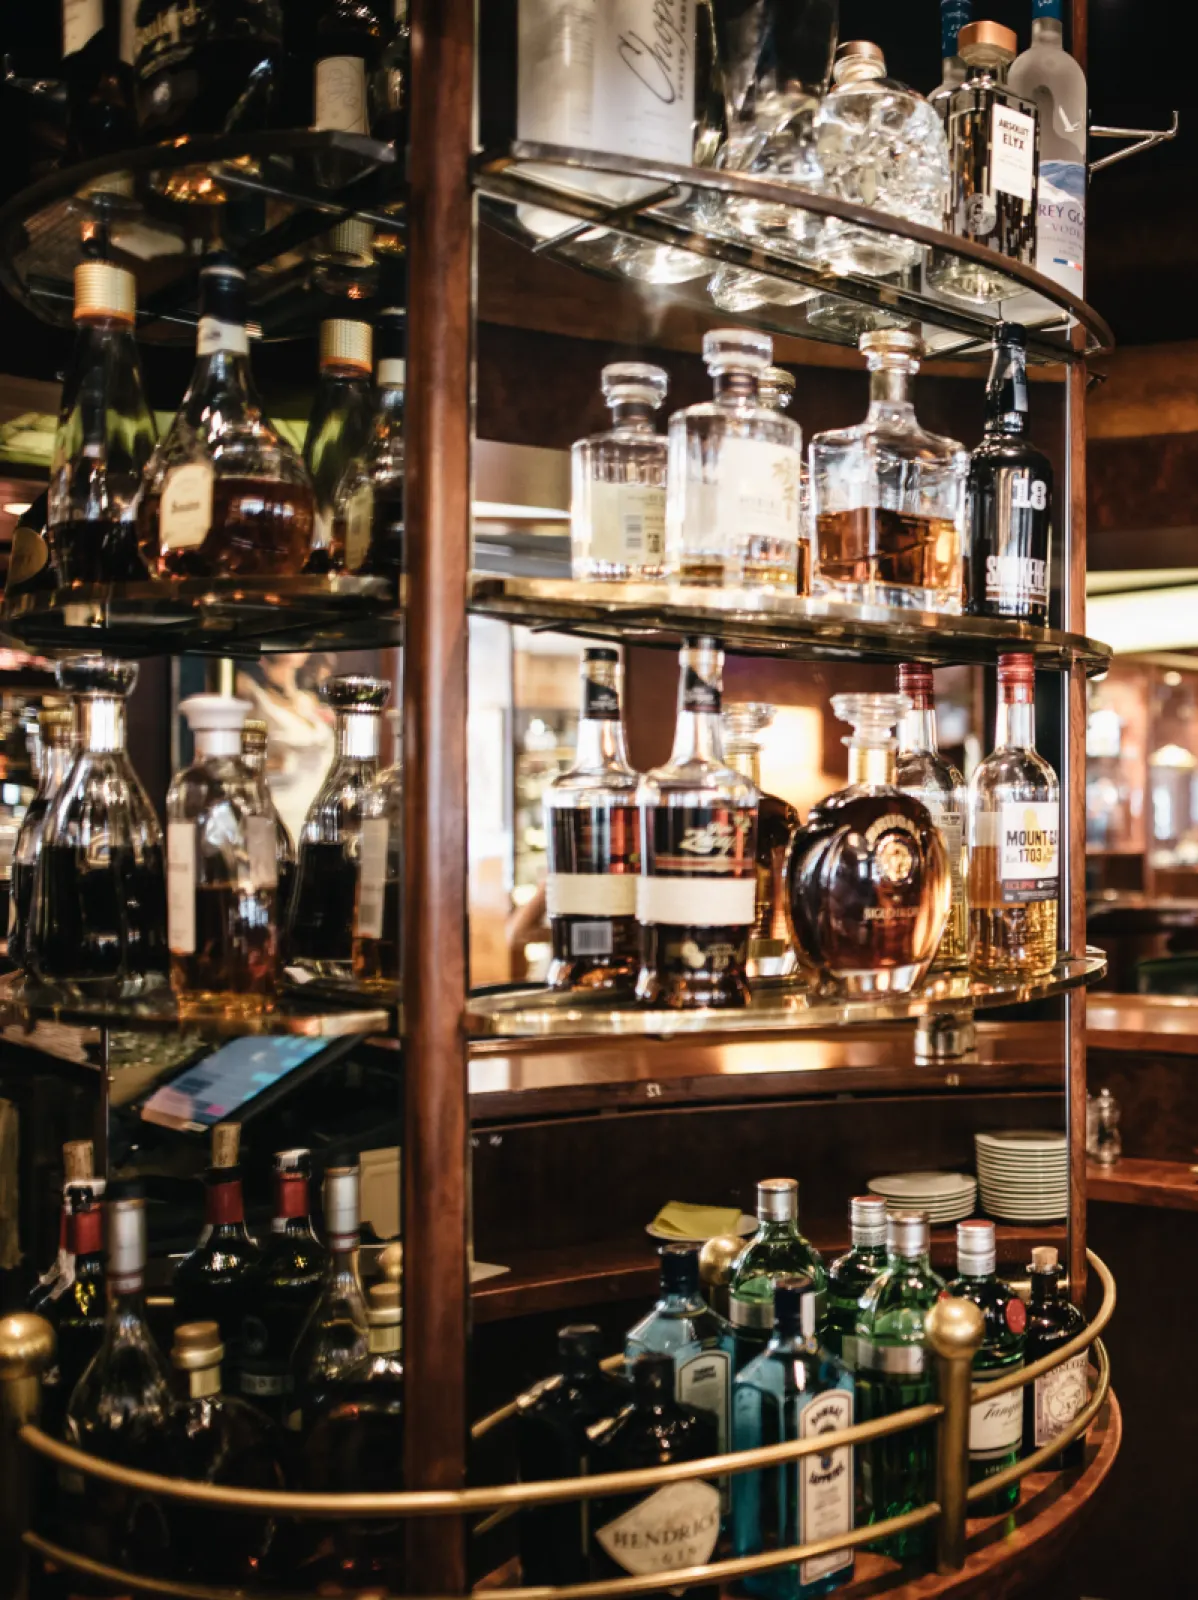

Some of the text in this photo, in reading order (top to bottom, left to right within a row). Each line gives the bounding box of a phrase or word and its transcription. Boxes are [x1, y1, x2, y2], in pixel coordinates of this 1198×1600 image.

[998, 118, 1029, 136] ABSOLUT
[1002, 133, 1024, 151] ELYX
[1038, 203, 1064, 218] REY
[1012, 479, 1046, 510] 18
[1006, 829, 1047, 847] MOUNT
[1018, 847, 1042, 863] 1703
